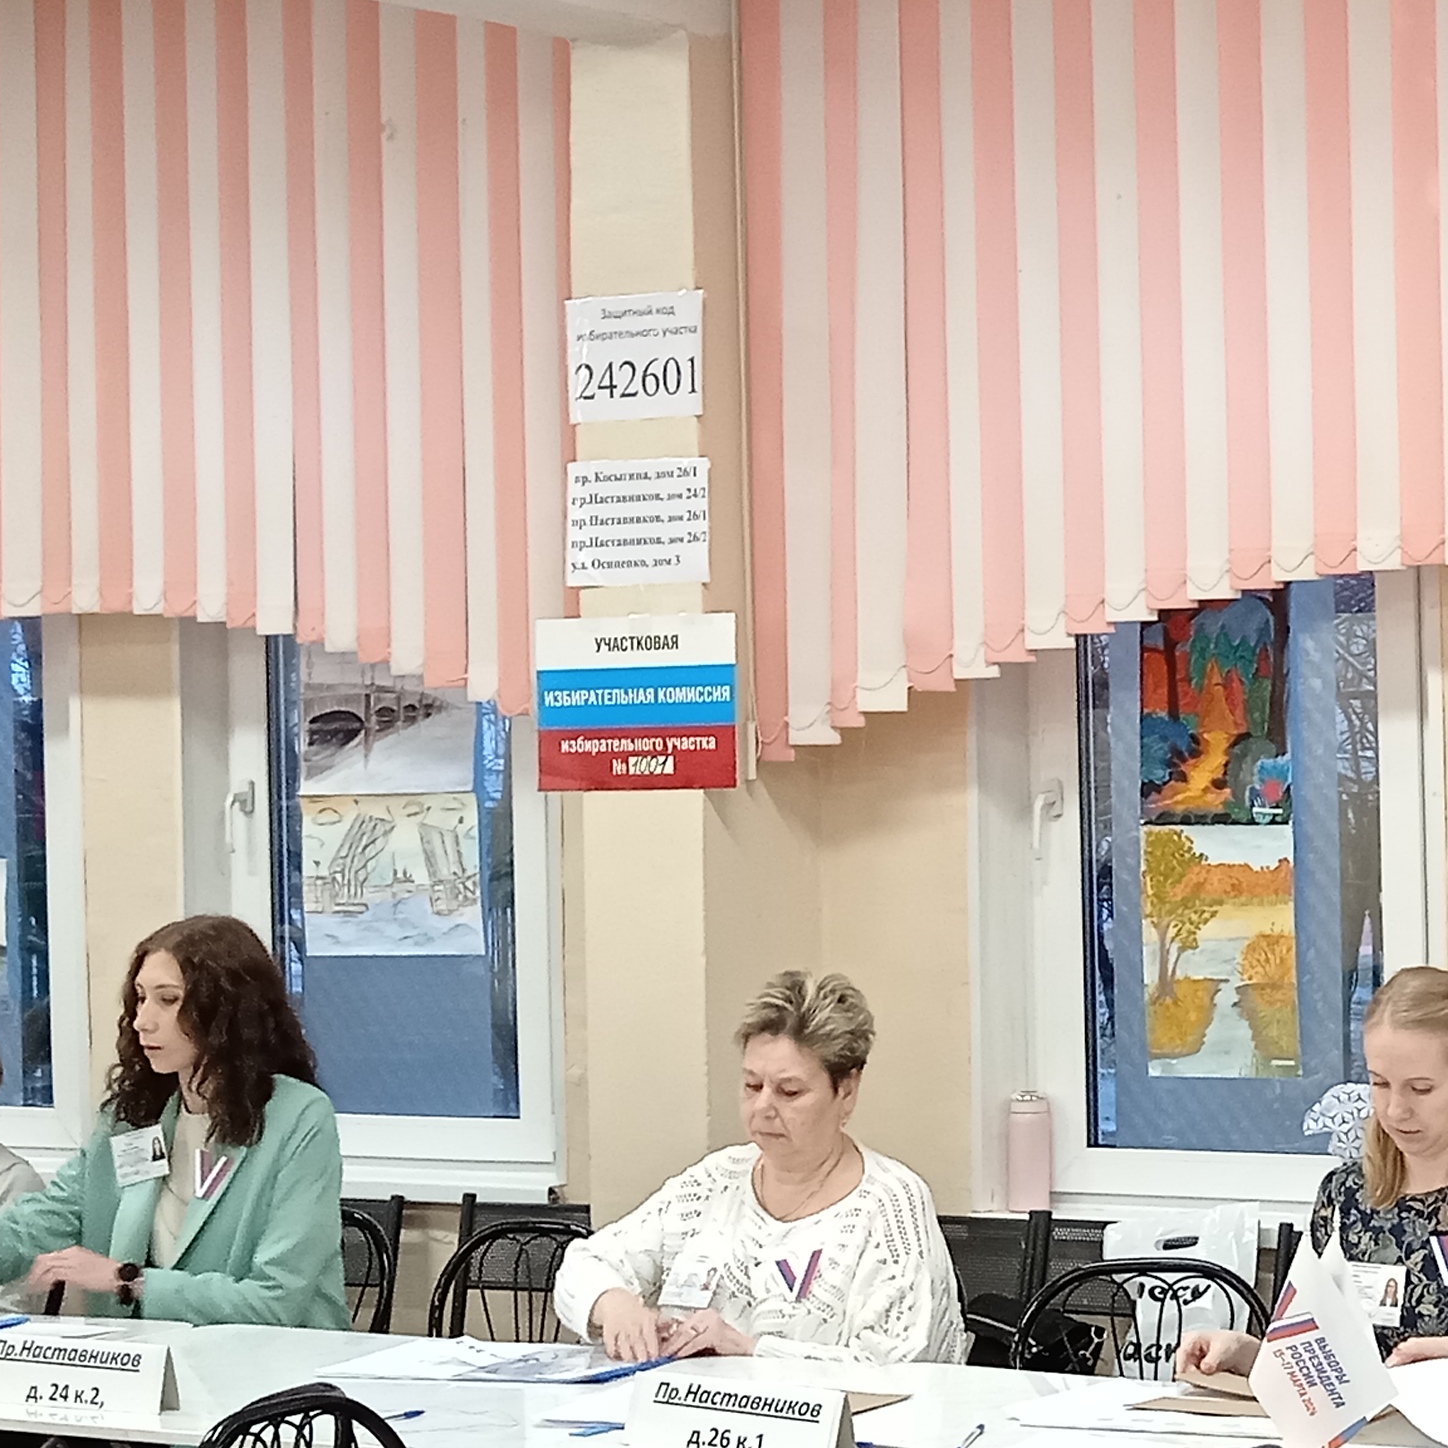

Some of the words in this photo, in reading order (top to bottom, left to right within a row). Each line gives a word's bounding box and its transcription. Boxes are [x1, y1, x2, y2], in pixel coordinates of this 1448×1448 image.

[574, 356, 699, 401] 242601
[594, 634, 680, 653] УЧАСТКОВАЯ
[544, 687, 655, 707] ИЗБИРАТЕЛЬНАЯ
[658, 685, 731, 704] КОМИССИЯ
[560, 736, 663, 756] избирательного
[666, 735, 717, 753] участка
[1285, 1344, 1318, 1389] РОССИИ
[1299, 1340, 1346, 1409] ПРЕЗИДЕНТА
[1314, 1336, 1351, 1386] ВЫБОРЫ
[25, 1385, 43, 1403] д.
[48, 1383, 70, 1402] 24
[73, 1387, 104, 1409] к.2,
[654, 1381, 823, 1419] Пр.Наставников
